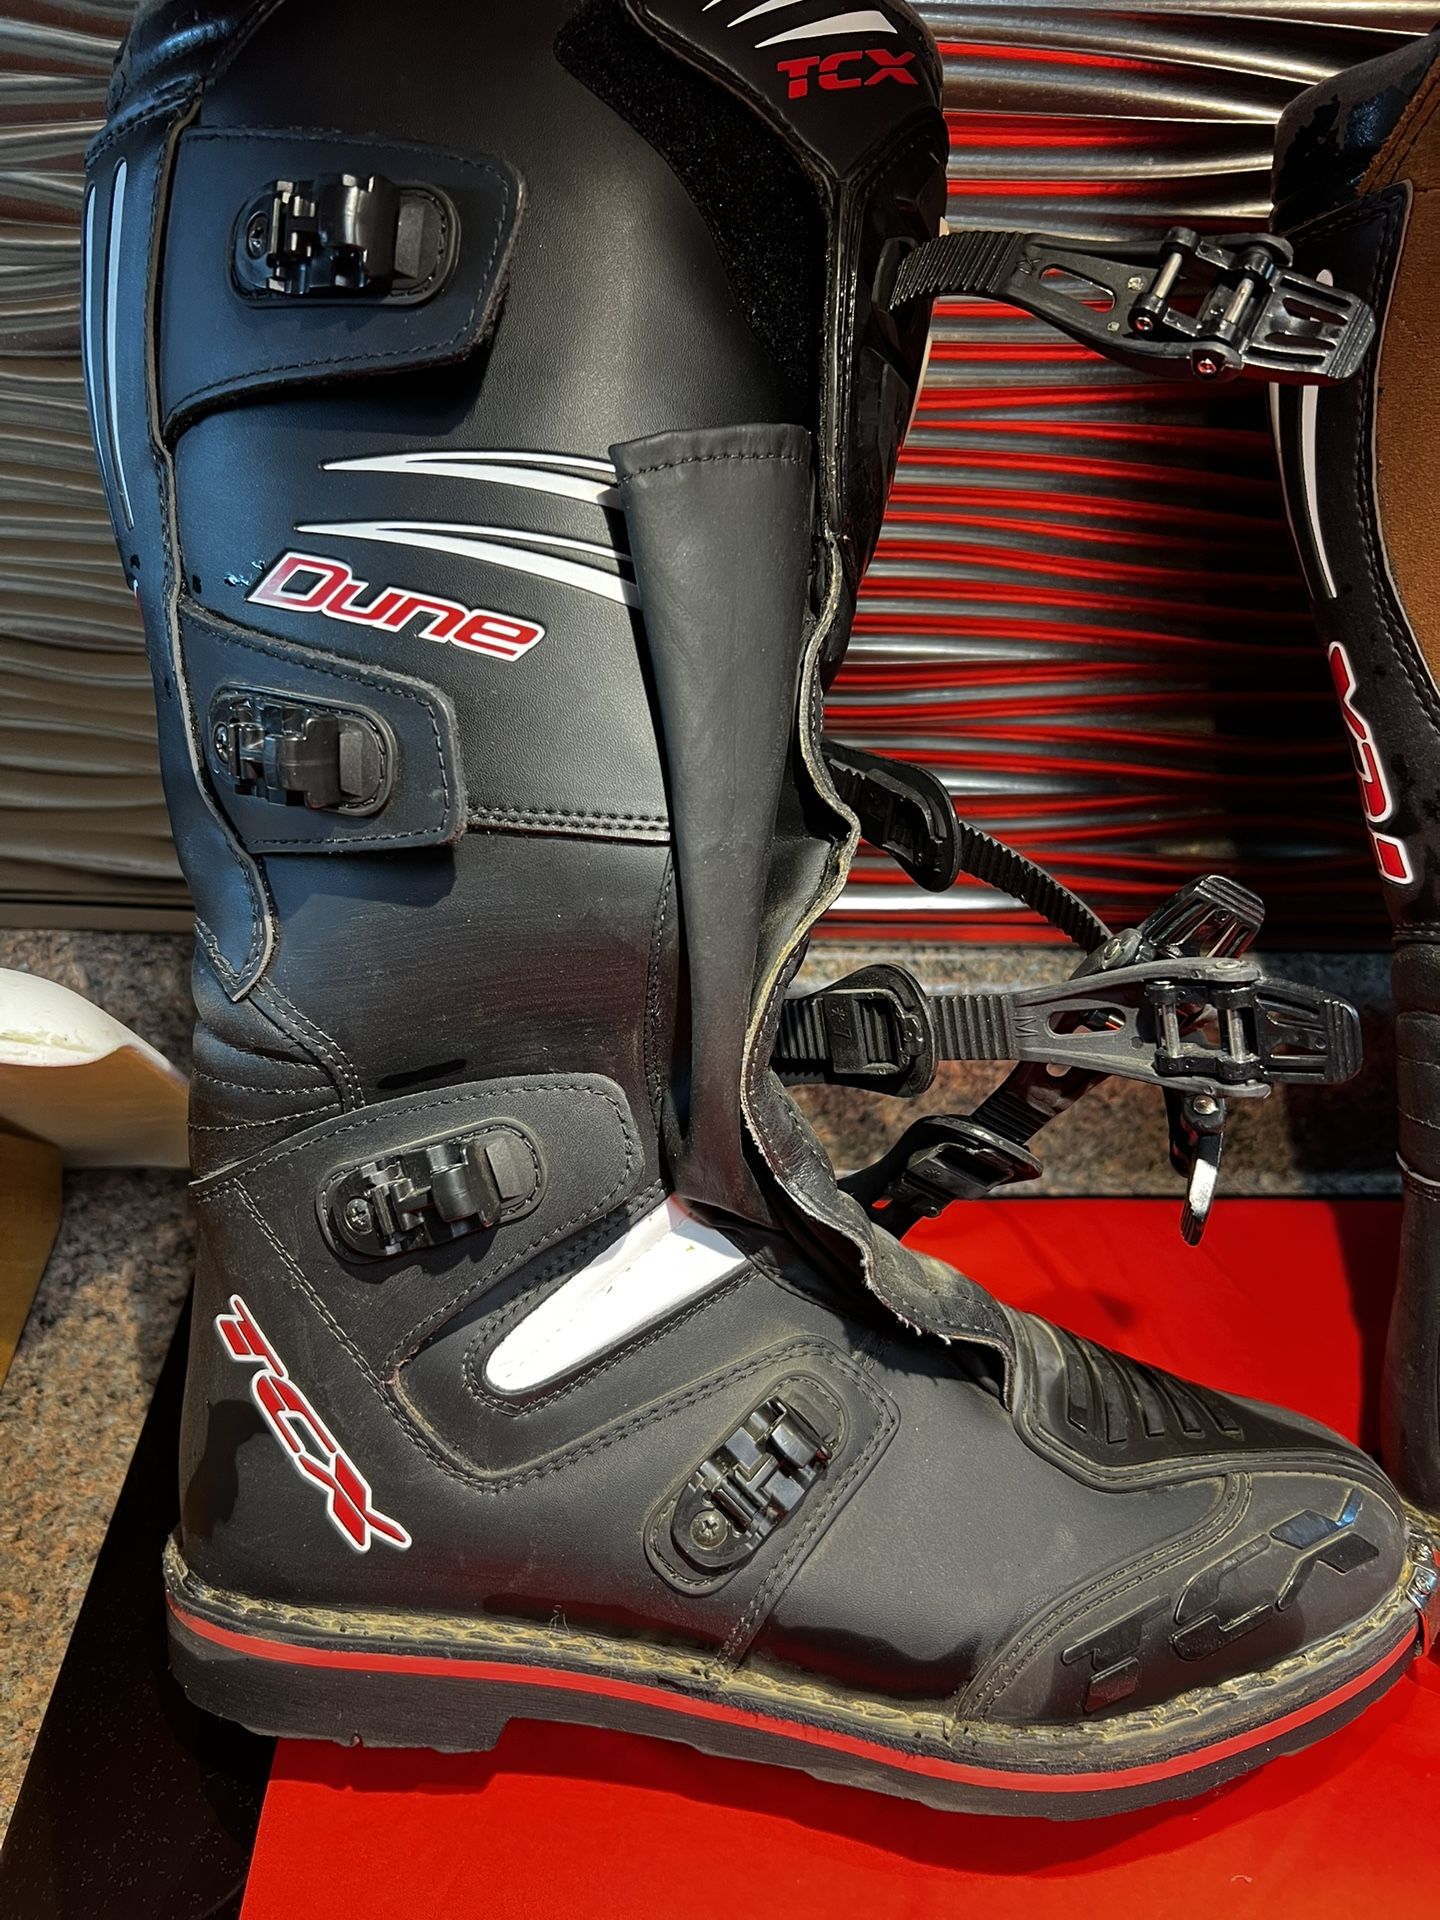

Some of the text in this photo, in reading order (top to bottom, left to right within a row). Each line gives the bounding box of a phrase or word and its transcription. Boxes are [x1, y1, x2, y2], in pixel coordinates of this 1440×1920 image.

[777, 49, 918, 99] TCX
[246, 552, 545, 661] Dune
[216, 1294, 412, 1551] TCX
[1061, 1488, 1380, 1712] TCX
